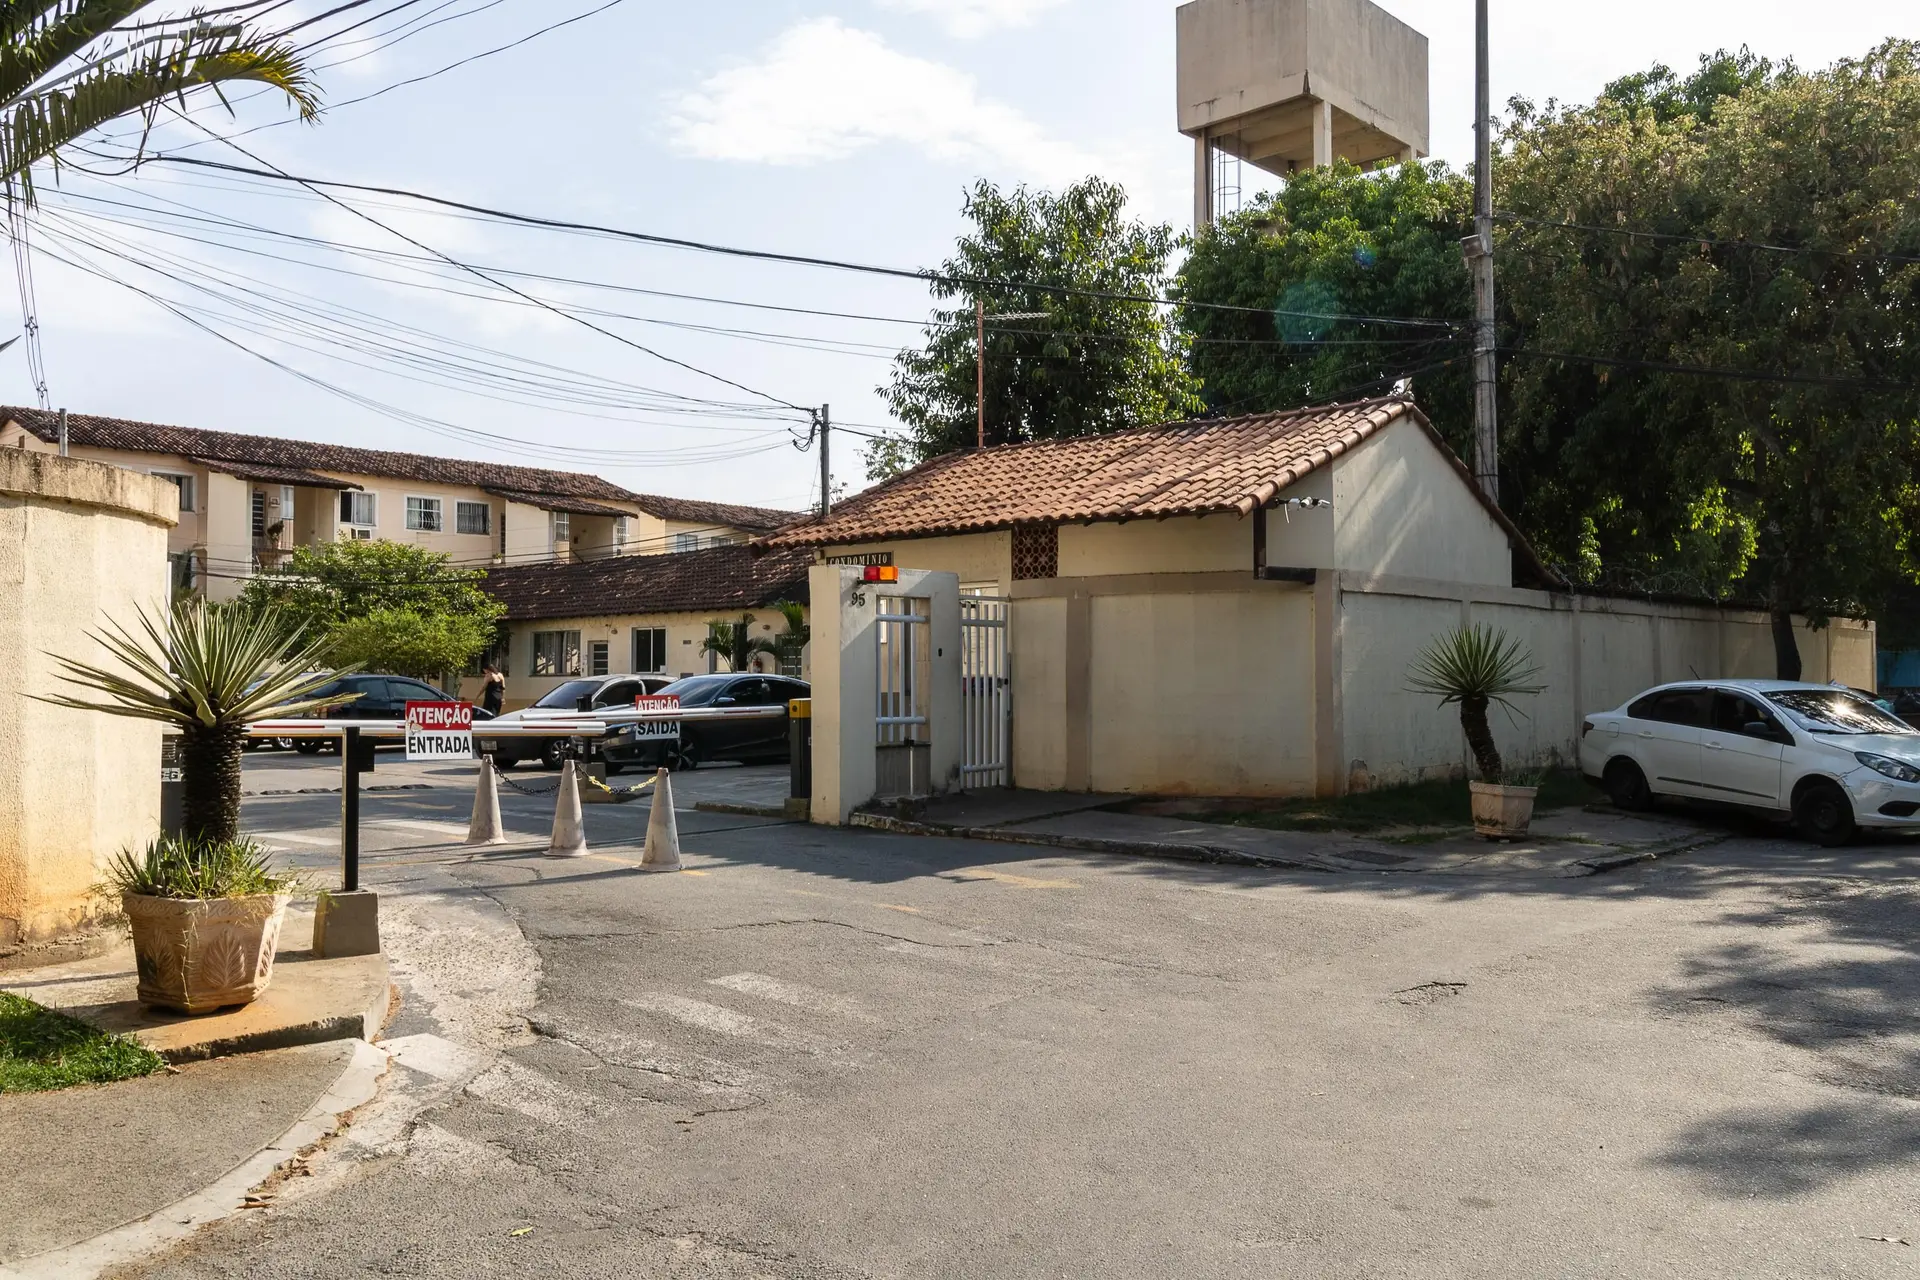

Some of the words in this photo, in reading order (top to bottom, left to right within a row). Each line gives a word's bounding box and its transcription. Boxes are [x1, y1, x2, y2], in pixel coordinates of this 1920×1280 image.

[851, 592, 866, 607] 95
[408, 704, 471, 728] ATENÇÃO
[408, 736, 471, 754] ENTRADA
